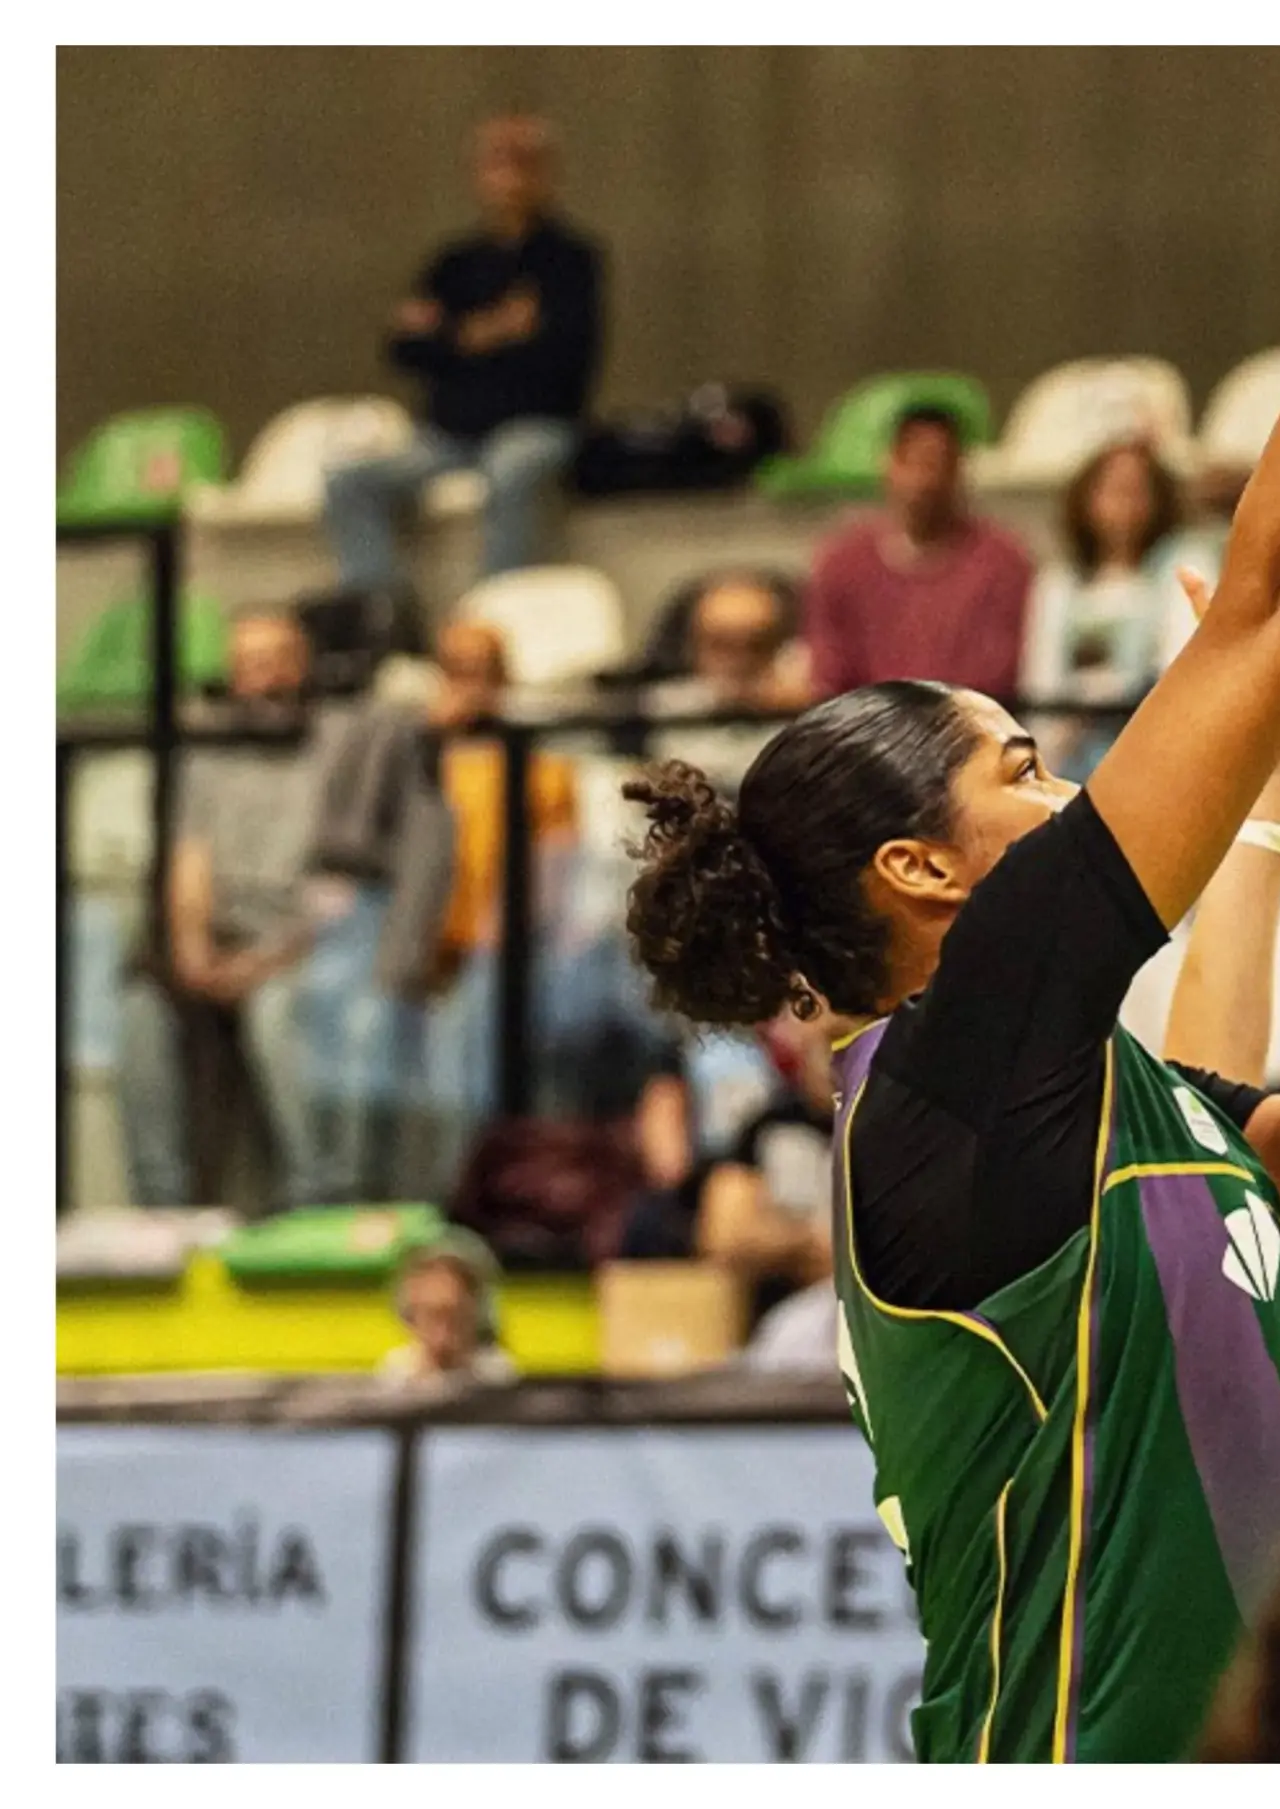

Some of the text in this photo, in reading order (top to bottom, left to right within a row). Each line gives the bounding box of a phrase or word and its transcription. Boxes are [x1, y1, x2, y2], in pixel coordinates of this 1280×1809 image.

[474, 1524, 918, 1632] CONCE
[56, 1686, 238, 1764] TES
[546, 1667, 704, 1764] DE
